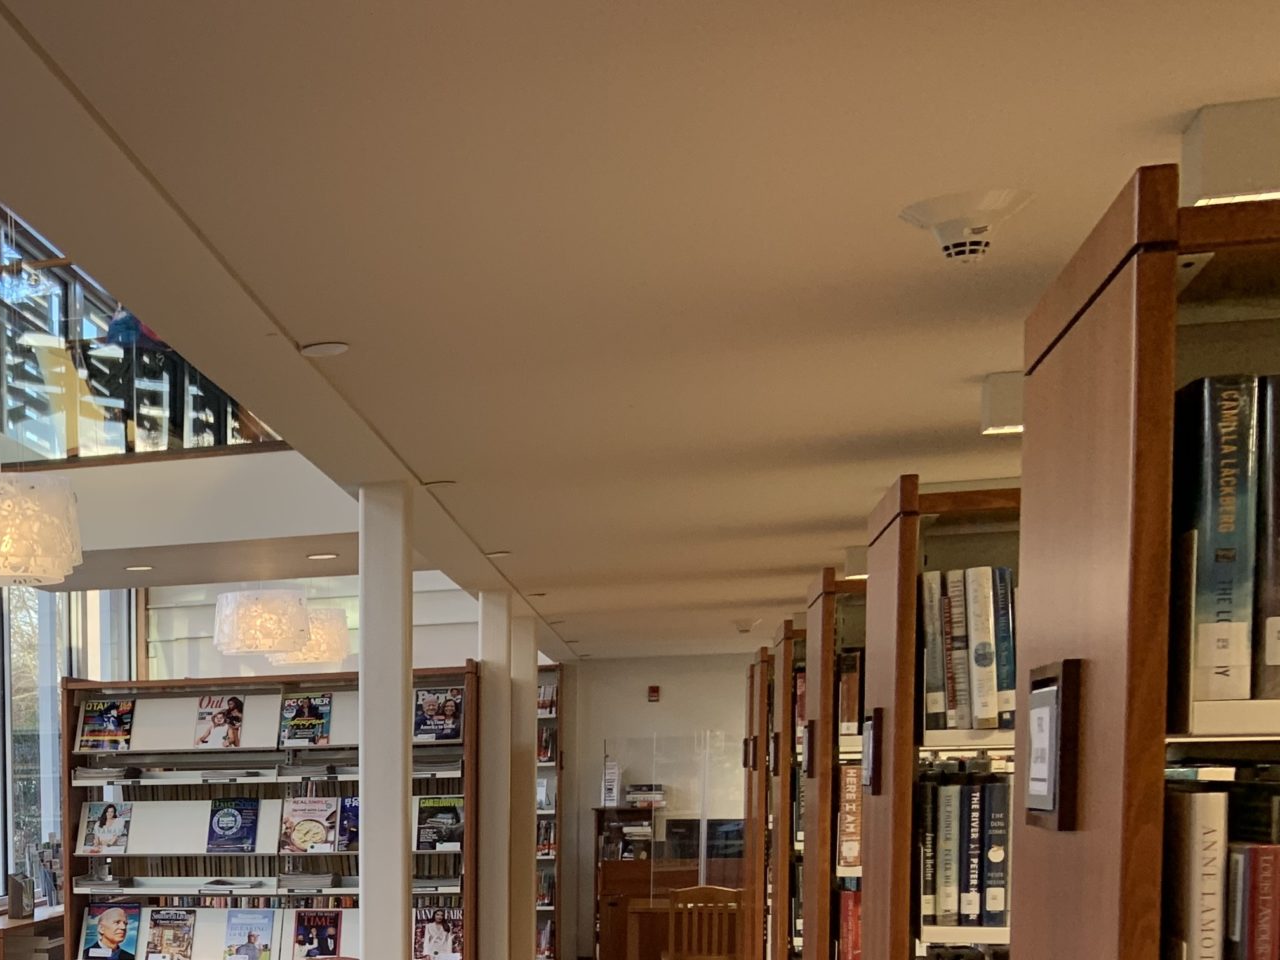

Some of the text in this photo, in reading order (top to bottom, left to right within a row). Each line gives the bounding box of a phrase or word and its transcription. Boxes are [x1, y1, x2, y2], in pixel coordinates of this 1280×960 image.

[1218, 390, 1239, 454] CAMILLA
[1215, 580, 1233, 604] THE
[284, 697, 330, 707] PC GMER
[846, 769, 857, 832] HERE I AM
[969, 792, 980, 809] THE
[969, 812, 980, 839] RIVER
[923, 832, 934, 881] Joseph Heller
[1199, 825, 1218, 882] ANNE
[969, 858, 979, 886] PETER
[1260, 855, 1274, 892] LOUIS
[304, 917, 334, 926] TIME
[445, 909, 462, 920] FAIR
